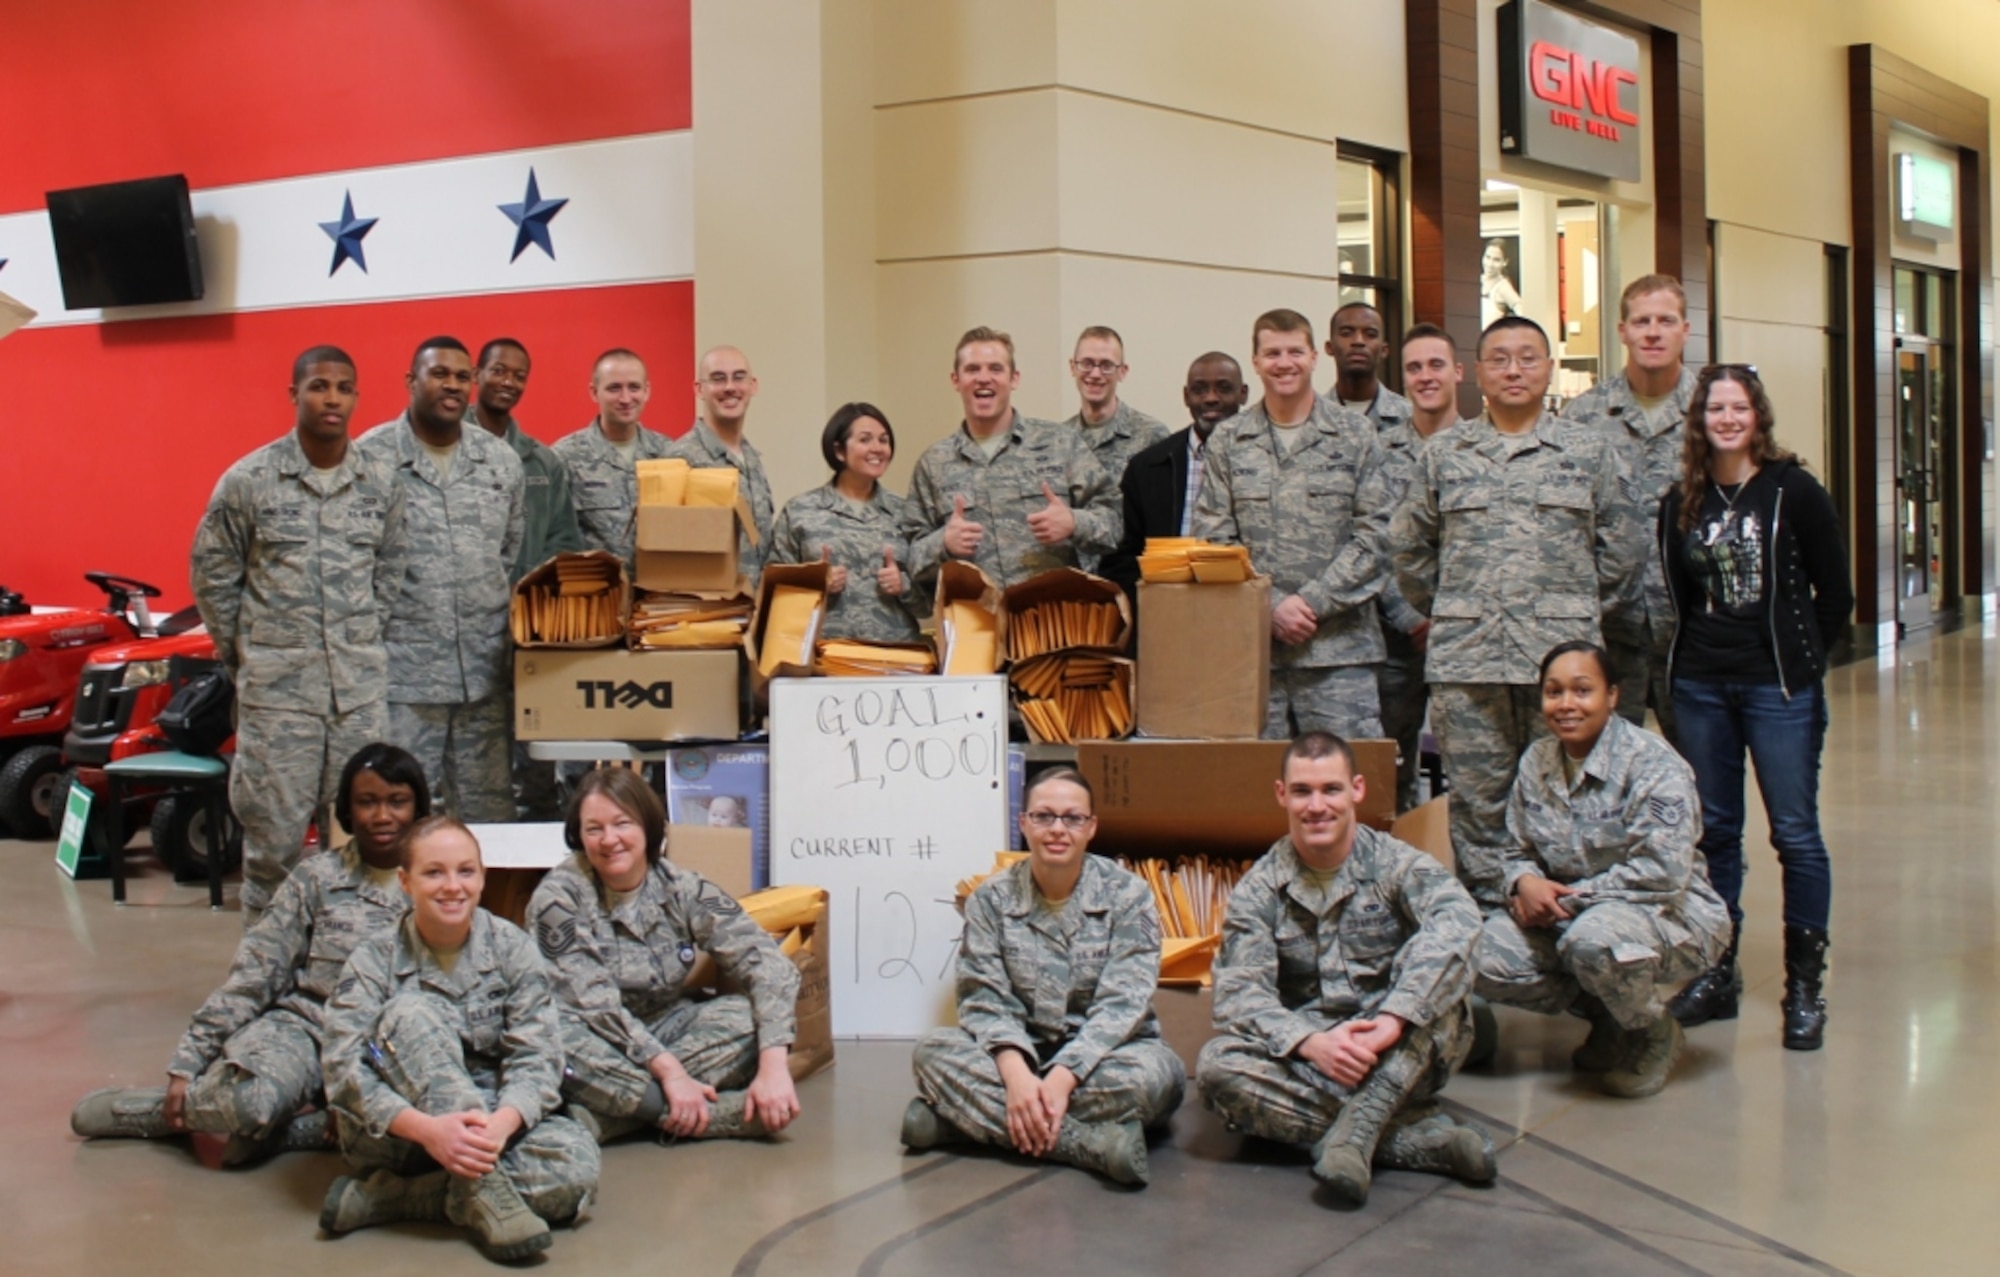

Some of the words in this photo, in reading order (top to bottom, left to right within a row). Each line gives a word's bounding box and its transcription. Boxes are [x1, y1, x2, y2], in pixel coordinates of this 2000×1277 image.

[1530, 40, 1639, 127] GNC
[1550, 109, 1581, 132] LIVE
[1585, 119, 1619, 142] WELL
[576, 679, 673, 709] DELL
[816, 684, 985, 736] GOAL:
[834, 720, 998, 791] 1,000!
[790, 836, 895, 860] CURRENT
[909, 834, 940, 861] #
